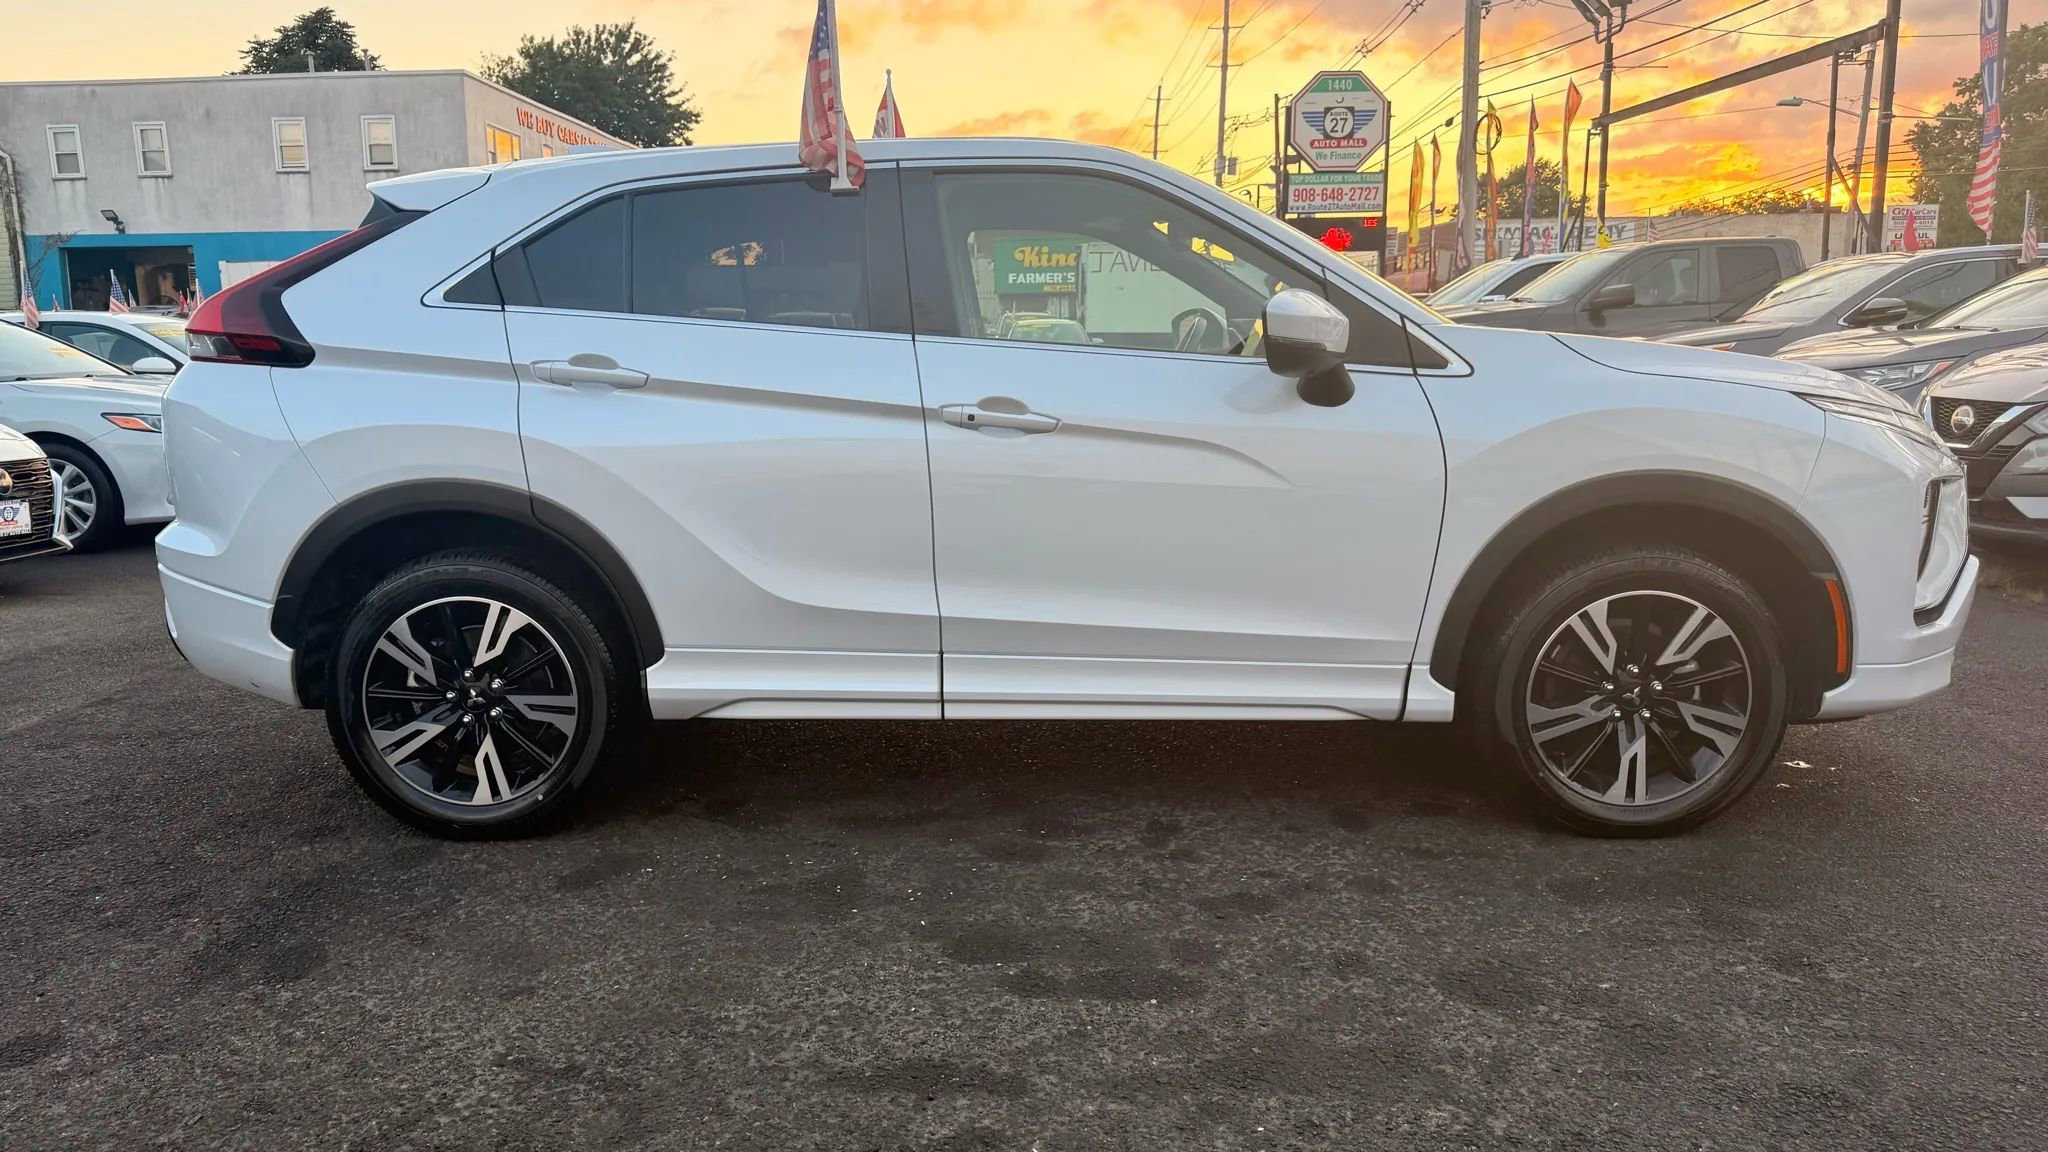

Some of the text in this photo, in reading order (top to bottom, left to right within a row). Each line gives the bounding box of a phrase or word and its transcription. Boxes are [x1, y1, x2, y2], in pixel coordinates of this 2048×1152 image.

[1328, 80, 1352, 90] 1440
[516, 107, 533, 129] WE
[535, 116, 554, 138] BUY
[1329, 117, 1348, 134] 27
[1313, 139, 1364, 148] AUTO MALL
[1315, 151, 1362, 160] We Finance
[1304, 175, 1329, 183] DOLLAR
[1362, 174, 1383, 182] TRADE
[1293, 186, 1379, 202] 908-648-2727
[1008, 272, 1076, 285] FARMER'S
